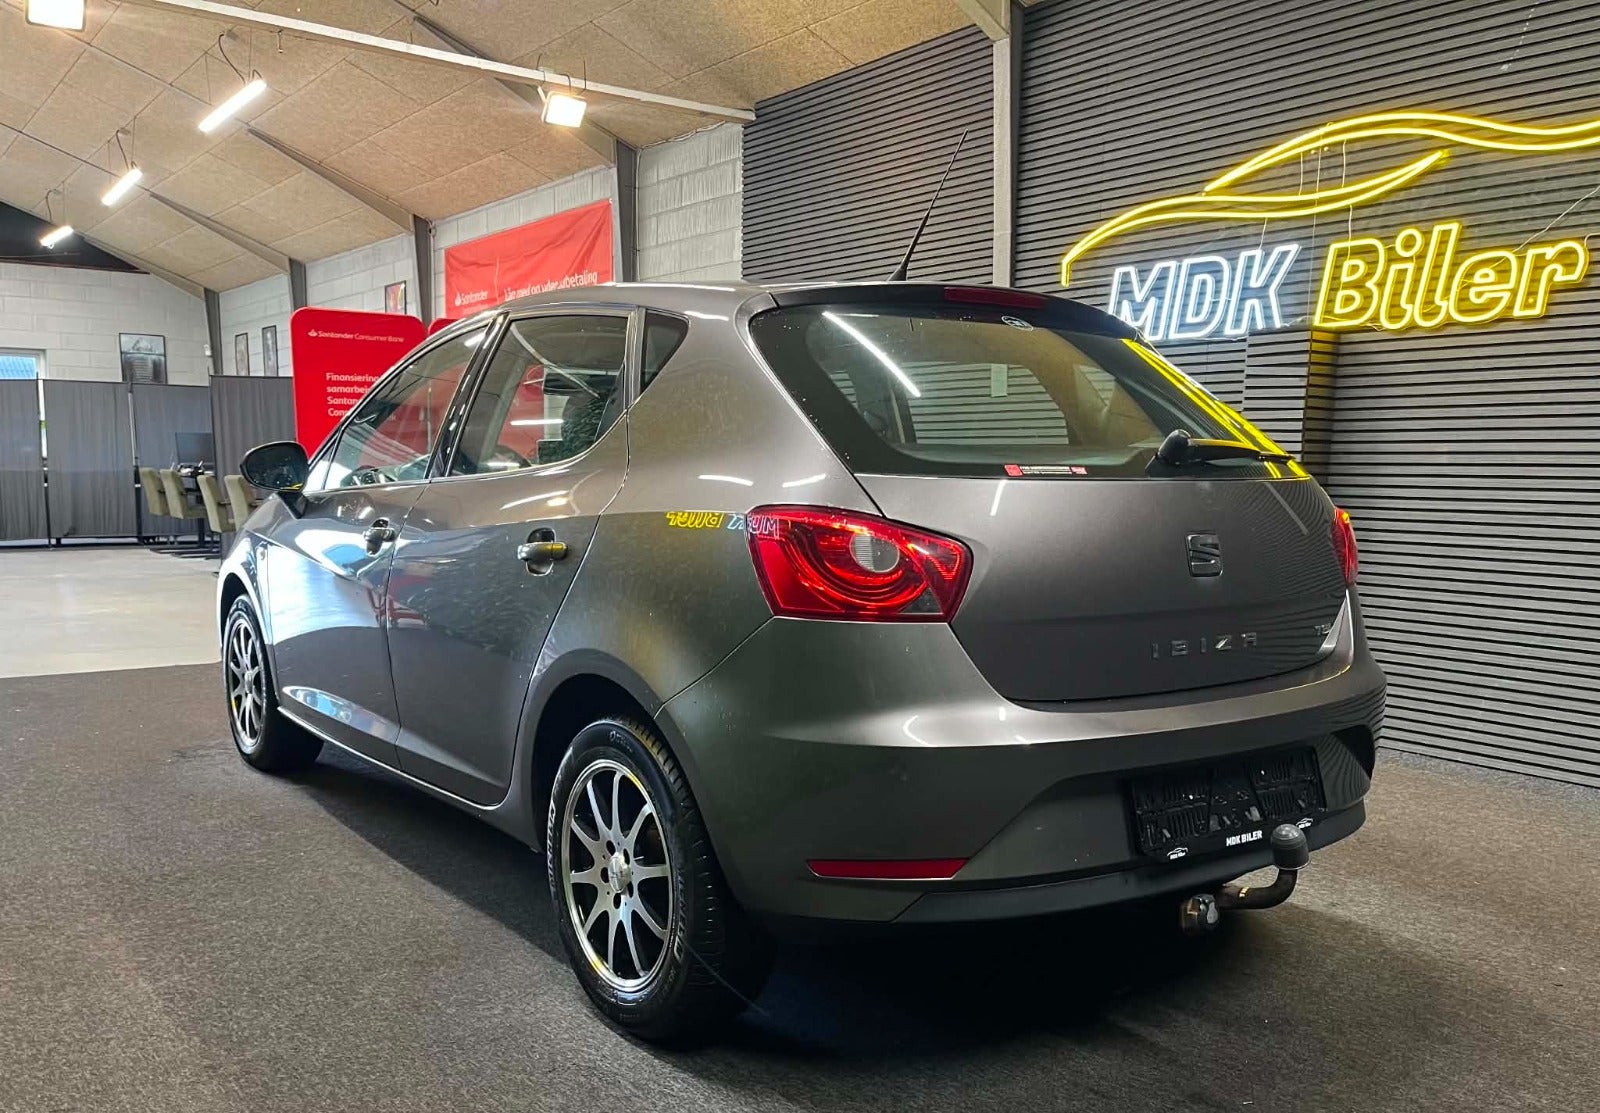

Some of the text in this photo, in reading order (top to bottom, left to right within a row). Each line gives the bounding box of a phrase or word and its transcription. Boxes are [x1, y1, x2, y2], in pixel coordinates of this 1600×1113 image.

[1108, 222, 1588, 340] MDK Biler
[318, 330, 354, 340] Santander
[354, 332, 387, 342] Consumer
[327, 395, 359, 405] Santan
[1152, 632, 1257, 659] IBIZA
[1226, 830, 1263, 847] MDK BILER
